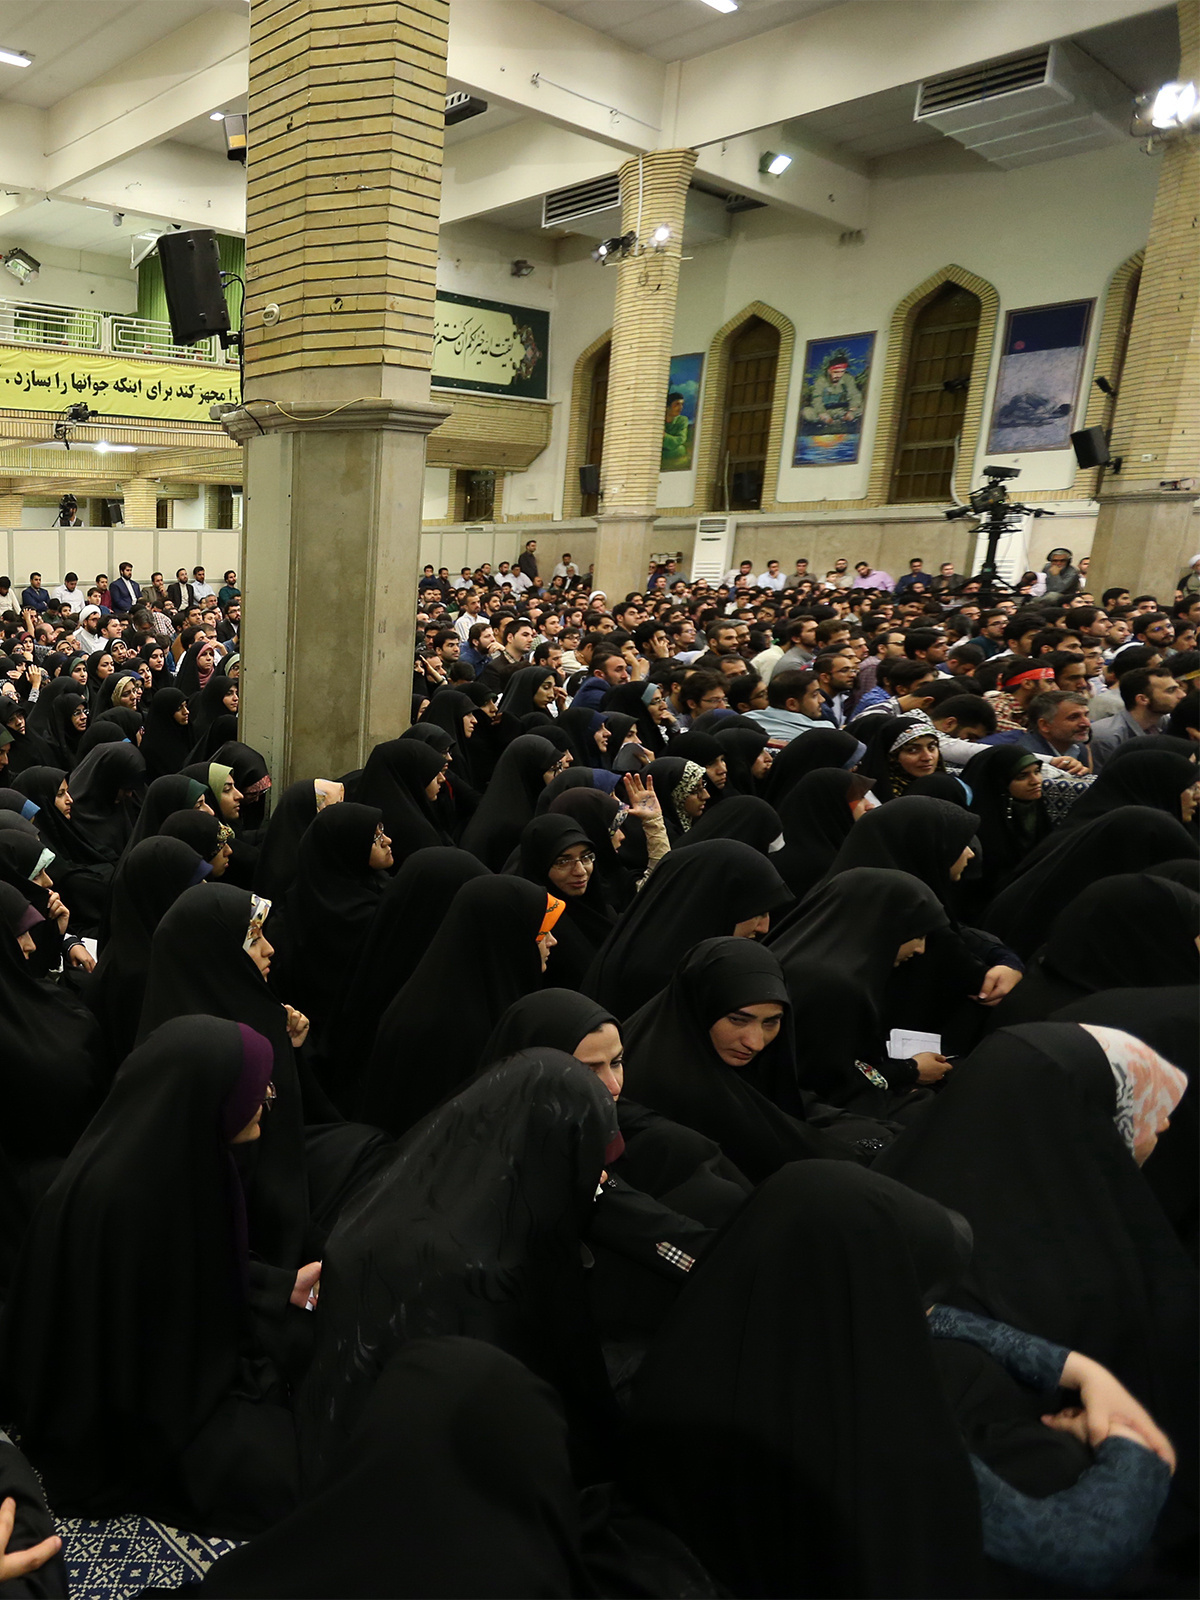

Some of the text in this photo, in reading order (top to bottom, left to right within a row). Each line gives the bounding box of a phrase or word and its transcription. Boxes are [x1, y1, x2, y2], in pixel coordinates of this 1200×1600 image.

[54, 372, 68, 394] را
[71, 372, 110, 396] جوانها
[113, 376, 142, 398] اینکه
[146, 380, 173, 401] برای
[176, 384, 196, 398] کند
[198, 387, 226, 405] مجهز
